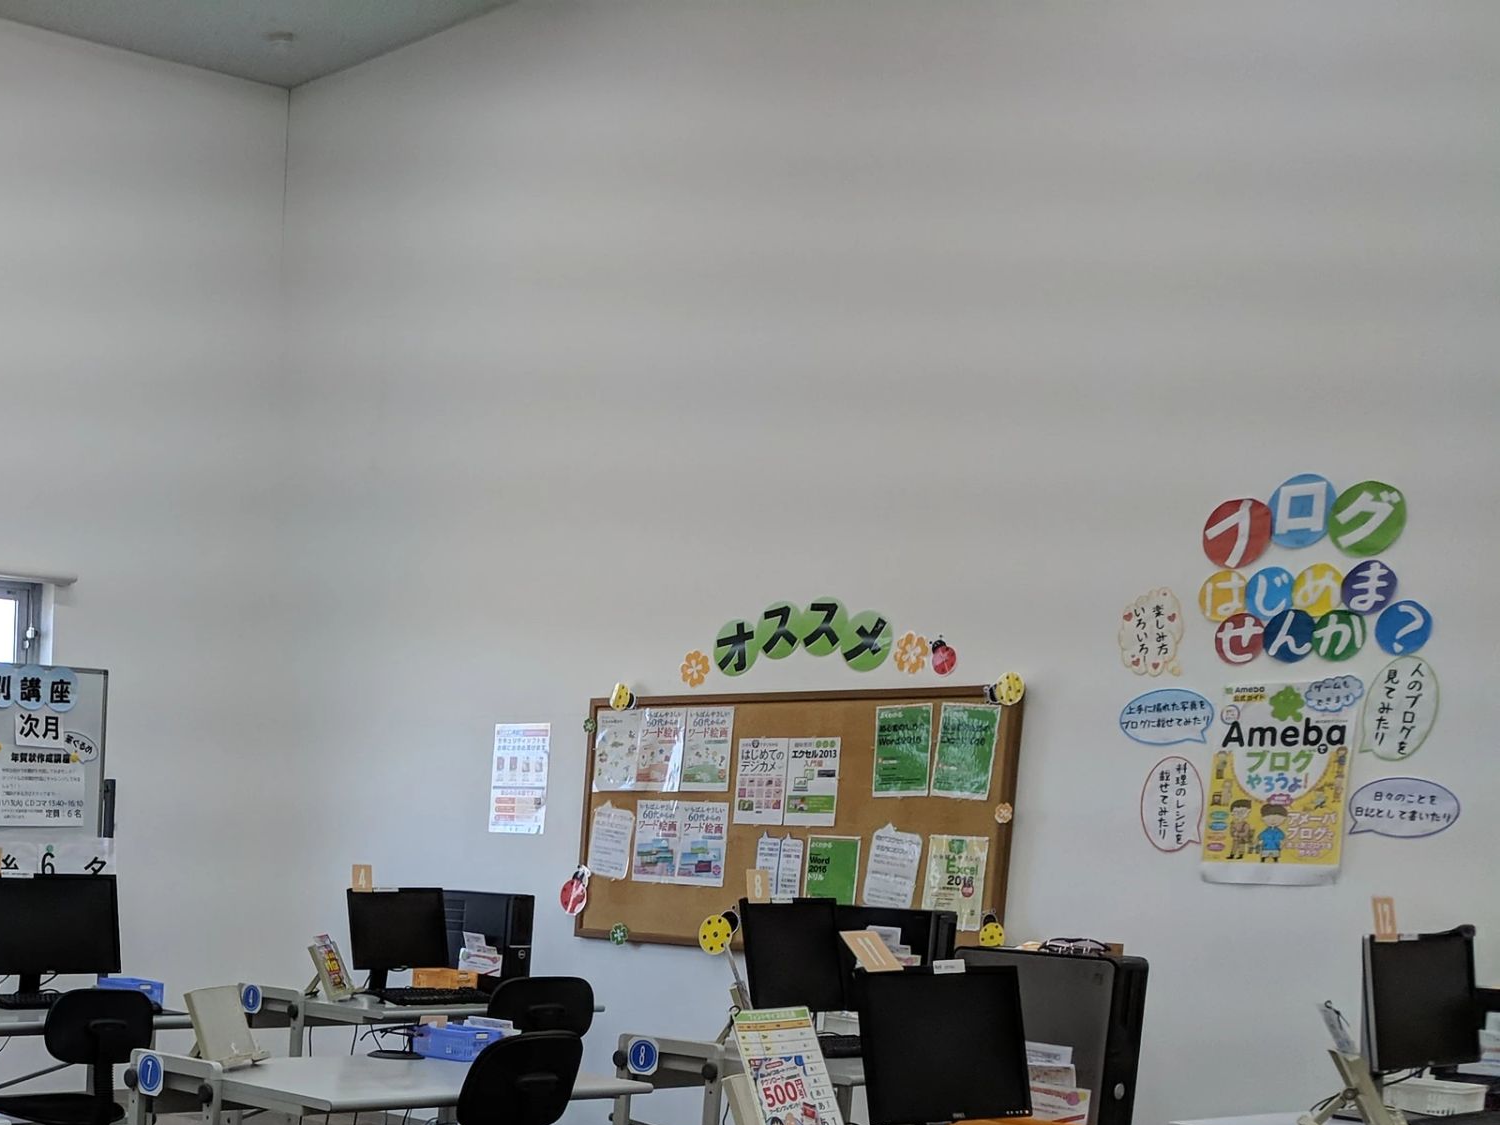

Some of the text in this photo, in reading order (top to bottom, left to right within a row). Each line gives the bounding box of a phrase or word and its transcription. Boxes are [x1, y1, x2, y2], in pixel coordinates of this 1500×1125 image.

[1205, 562, 1389, 617] はじめま
[717, 602, 887, 672] オススメ
[1152, 604, 1168, 656] 楽しみ方
[1374, 669, 1399, 746] 見てみたり
[1397, 662, 1425, 756] 人のブログを
[19, 713, 60, 741] 次月
[688, 728, 729, 739] ワード絵画
[1222, 717, 1346, 748] Ameba
[741, 749, 785, 761] はじめての
[792, 749, 838, 759] エクセル2013
[1247, 751, 1315, 772] ブログ
[740, 761, 777, 773] デジカメ
[1175, 762, 1188, 845] 料理のレシピを
[1373, 791, 1437, 806] 日々のことを
[1287, 812, 1337, 825] アメーバ
[1354, 806, 1451, 824] 日記として書いたり
[638, 820, 677, 831] ワード絵画
[684, 823, 724, 834] ワード絵画
[809, 856, 831, 865] Word
[946, 861, 979, 876] Excel
[358, 868, 367, 888] 4
[753, 874, 763, 897] 8
[947, 875, 975, 887] 2016
[639, 1045, 646, 1066] 8
[147, 1060, 153, 1084] 7
[762, 1081, 798, 1108] 500
